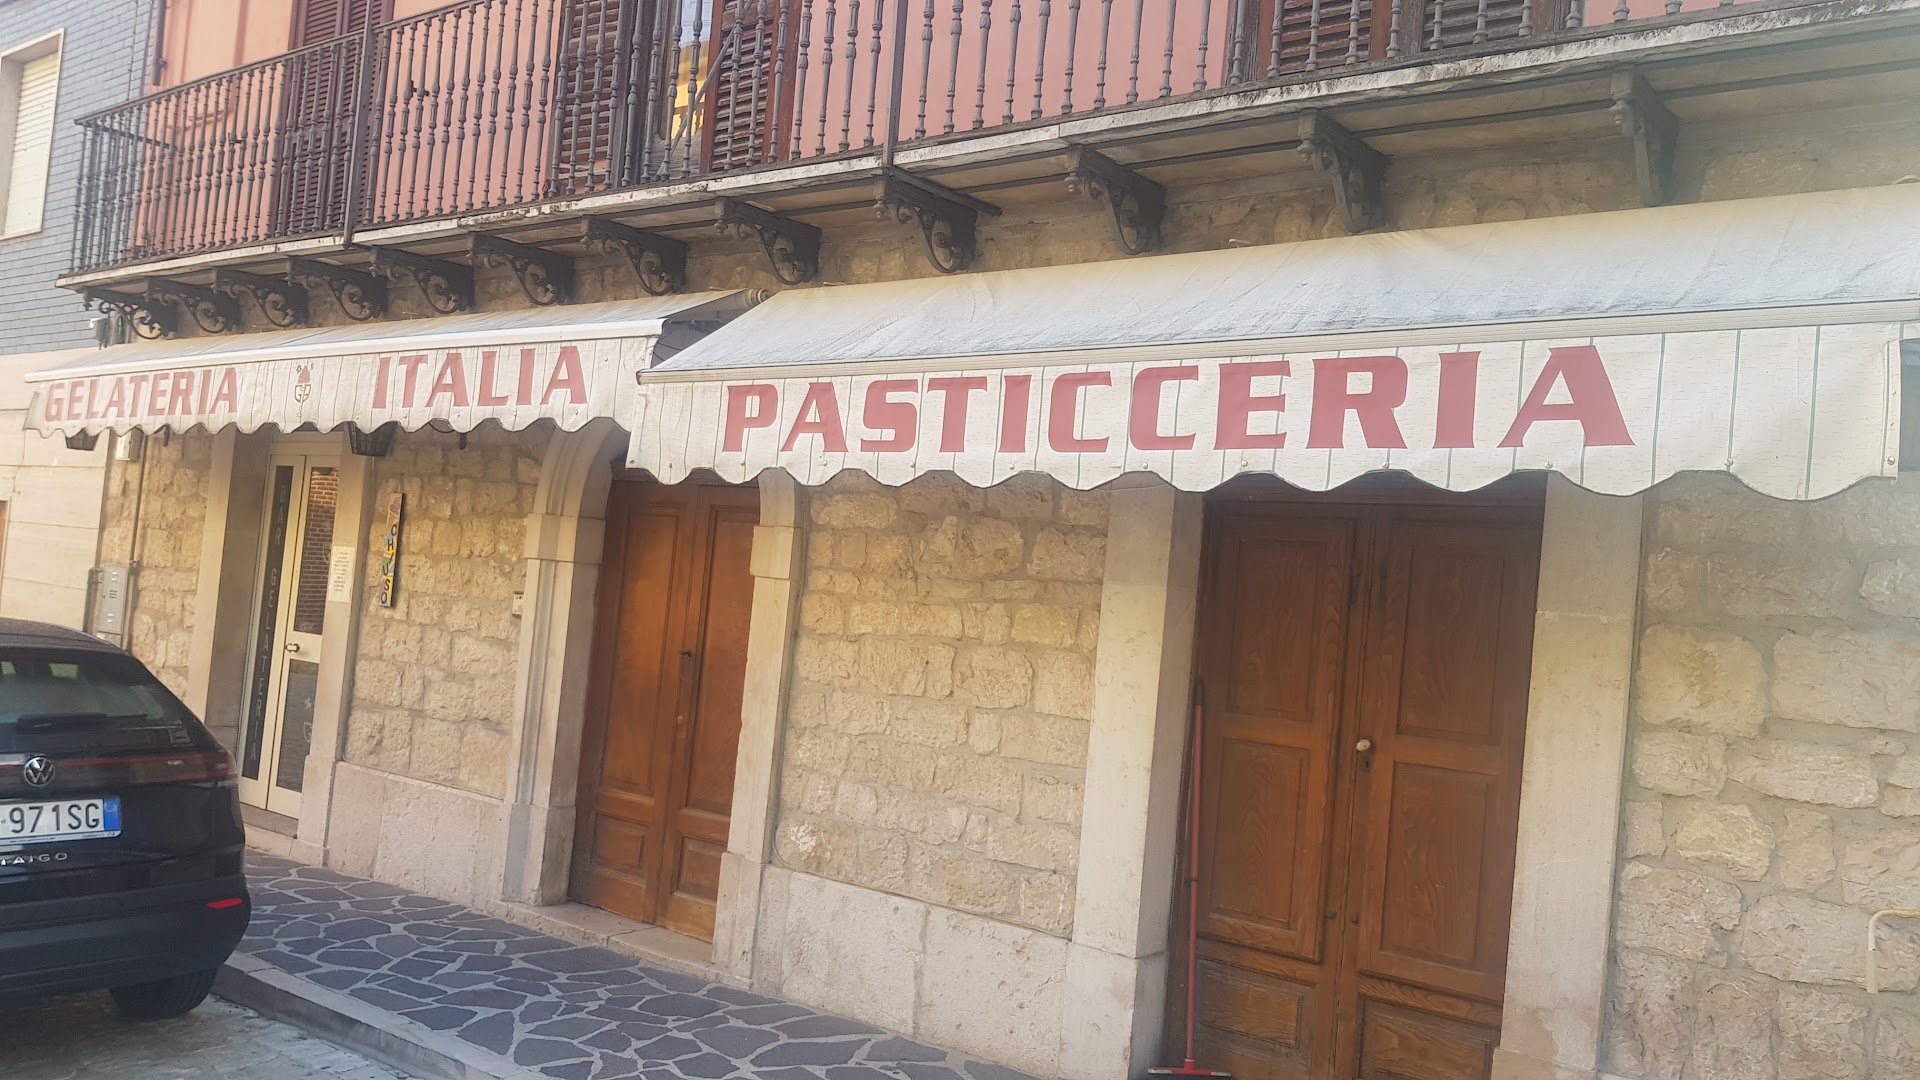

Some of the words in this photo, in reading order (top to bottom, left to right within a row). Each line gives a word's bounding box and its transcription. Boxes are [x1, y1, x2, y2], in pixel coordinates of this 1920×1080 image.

[44, 367, 238, 422] GELATERIA
[372, 346, 588, 409] ITALIA
[721, 344, 1635, 453] PASTICCERIA
[274, 484, 287, 545] BAR
[380, 524, 398, 604] CHIUSO
[250, 567, 278, 761] GELATERIA
